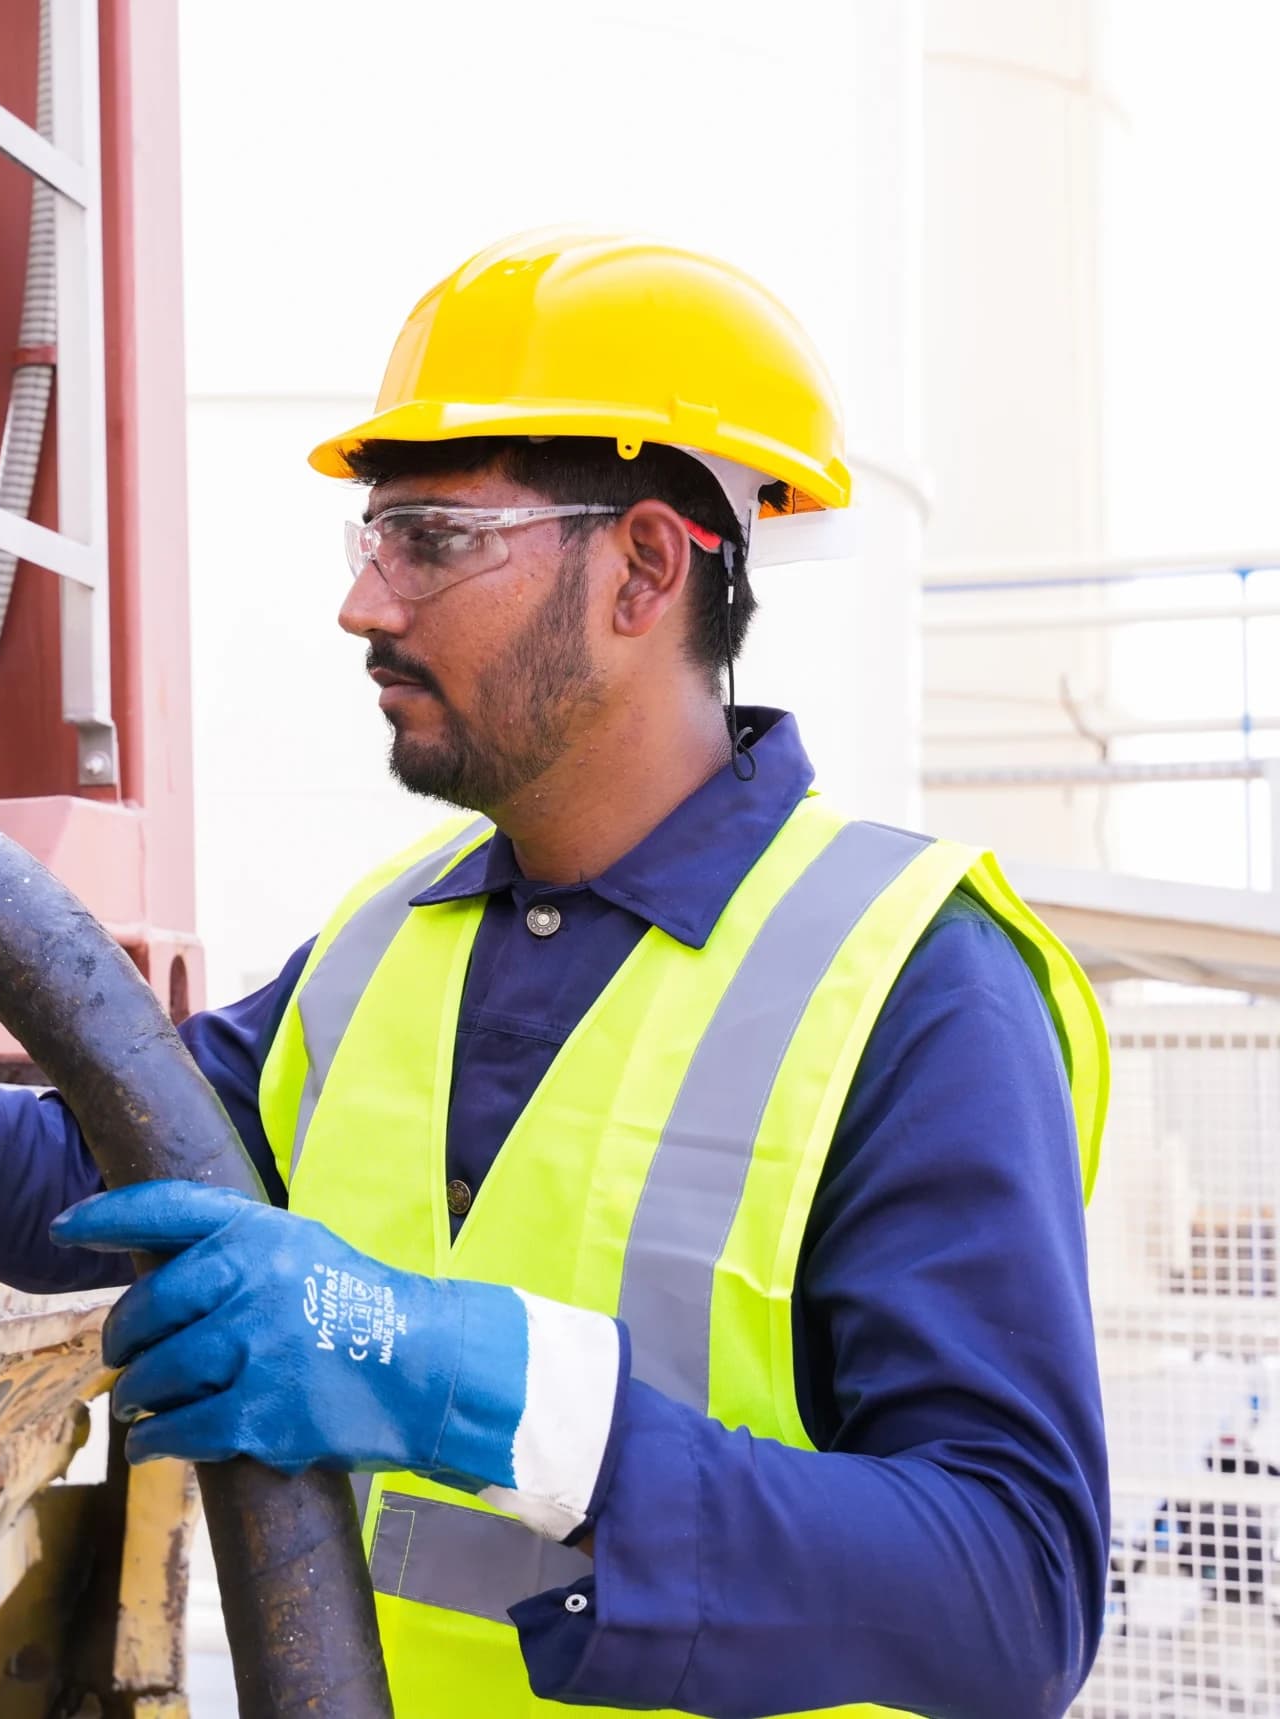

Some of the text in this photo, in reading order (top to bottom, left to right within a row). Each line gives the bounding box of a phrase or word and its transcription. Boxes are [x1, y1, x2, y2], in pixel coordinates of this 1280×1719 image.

[378, 1286, 396, 1365] MADE IN CHINA
